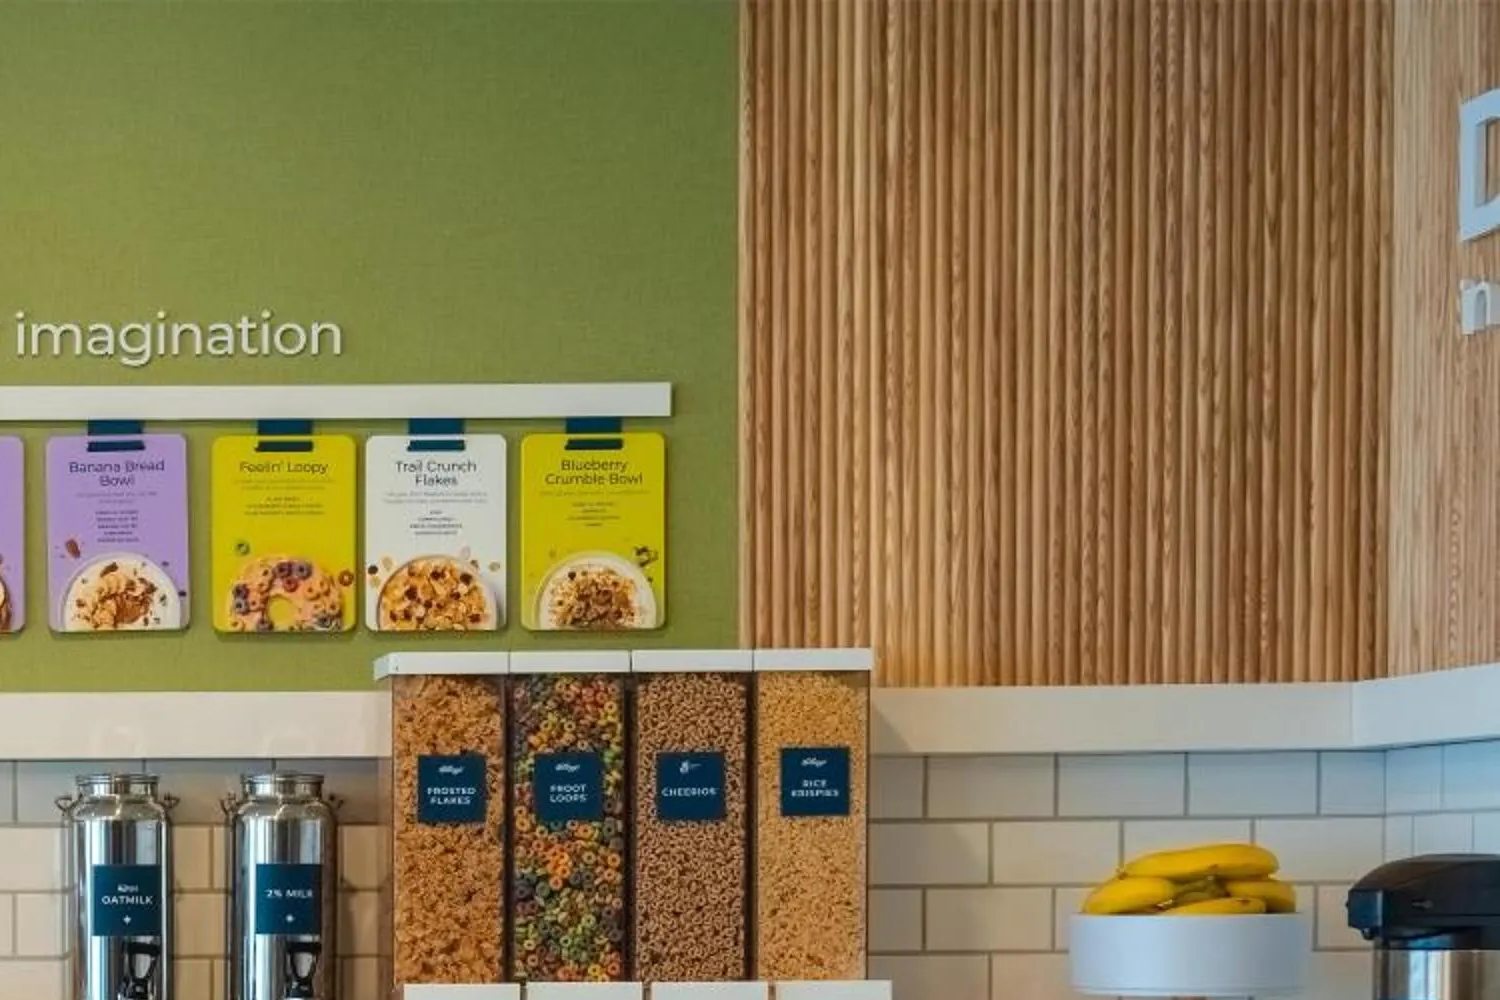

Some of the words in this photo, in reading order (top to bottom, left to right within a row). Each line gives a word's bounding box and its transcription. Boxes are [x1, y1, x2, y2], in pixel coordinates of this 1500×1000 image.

[14, 310, 343, 367] imagination
[68, 461, 121, 473] Banana
[125, 459, 165, 473] Bread
[287, 462, 329, 475] Loopy
[396, 460, 422, 473] Trail
[427, 460, 477, 473] Crunch
[561, 458, 627, 473] Blueberry
[99, 475, 134, 487] Bowl
[415, 473, 458, 487] Flakes
[545, 472, 605, 485] Crumble
[609, 472, 643, 485] Bowl
[430, 796, 472, 805] FLAKES
[550, 793, 588, 803] LOOPS
[101, 894, 153, 905] OATMILK
[265, 888, 283, 899] 2%
[285, 888, 313, 899] MILK
